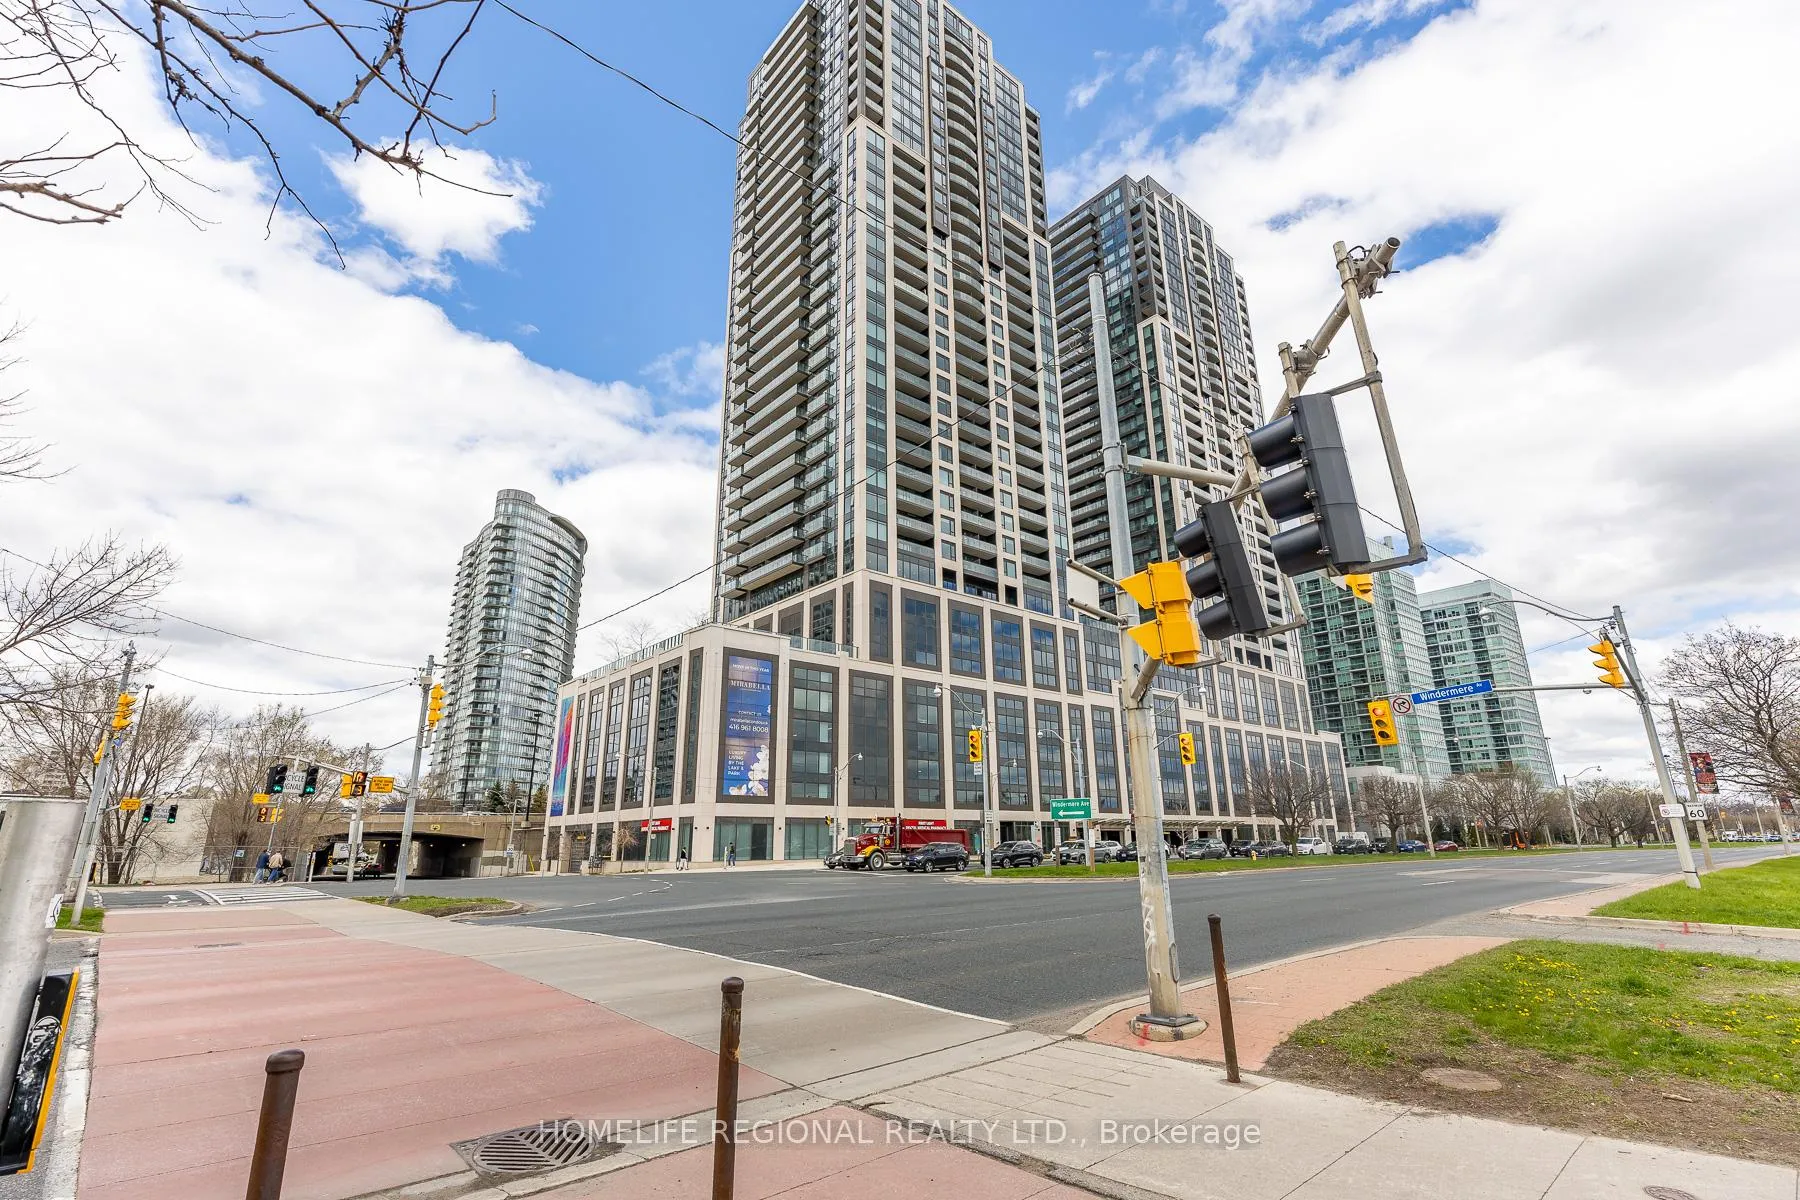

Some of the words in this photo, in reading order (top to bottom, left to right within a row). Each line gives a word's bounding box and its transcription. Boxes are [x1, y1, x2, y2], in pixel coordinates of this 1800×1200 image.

[730, 680, 770, 690] MIRABELLA
[1420, 685, 1474, 700] Windermere
[1690, 810, 1704, 818] 60
